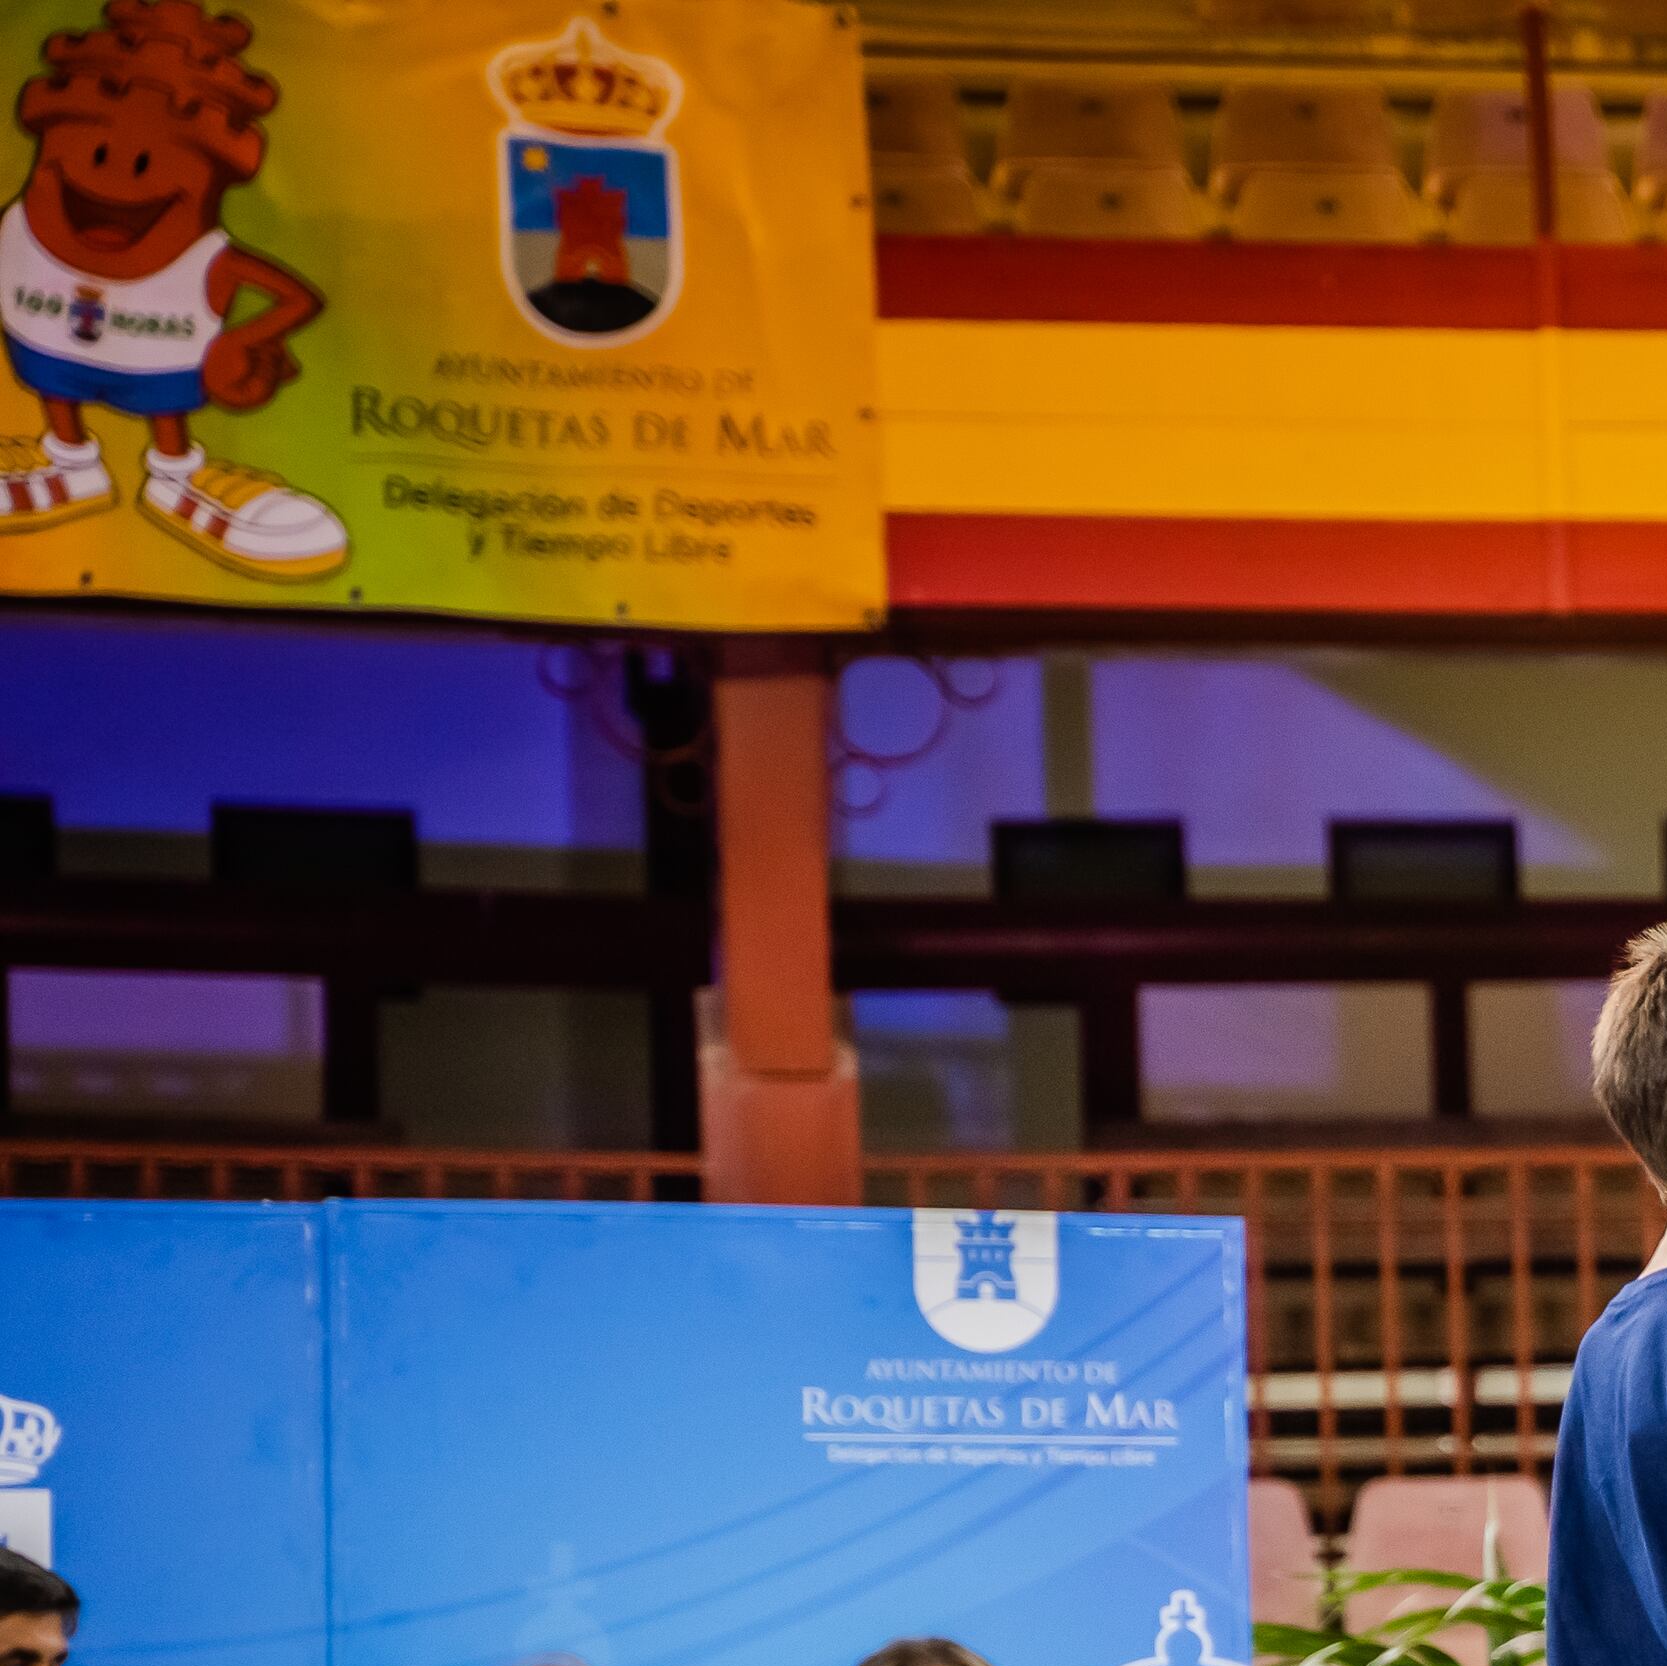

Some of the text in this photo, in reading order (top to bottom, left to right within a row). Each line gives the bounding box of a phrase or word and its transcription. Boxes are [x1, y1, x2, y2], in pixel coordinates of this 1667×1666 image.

[633, 409, 690, 450] DE
[381, 474, 817, 527] Delegación de Deportes
[504, 523, 633, 563] Tiempo
[643, 528, 734, 563] Libre
[865, 1358, 1118, 1385] AYUNTAMIENTO DE
[1021, 1397, 1065, 1428] DE
